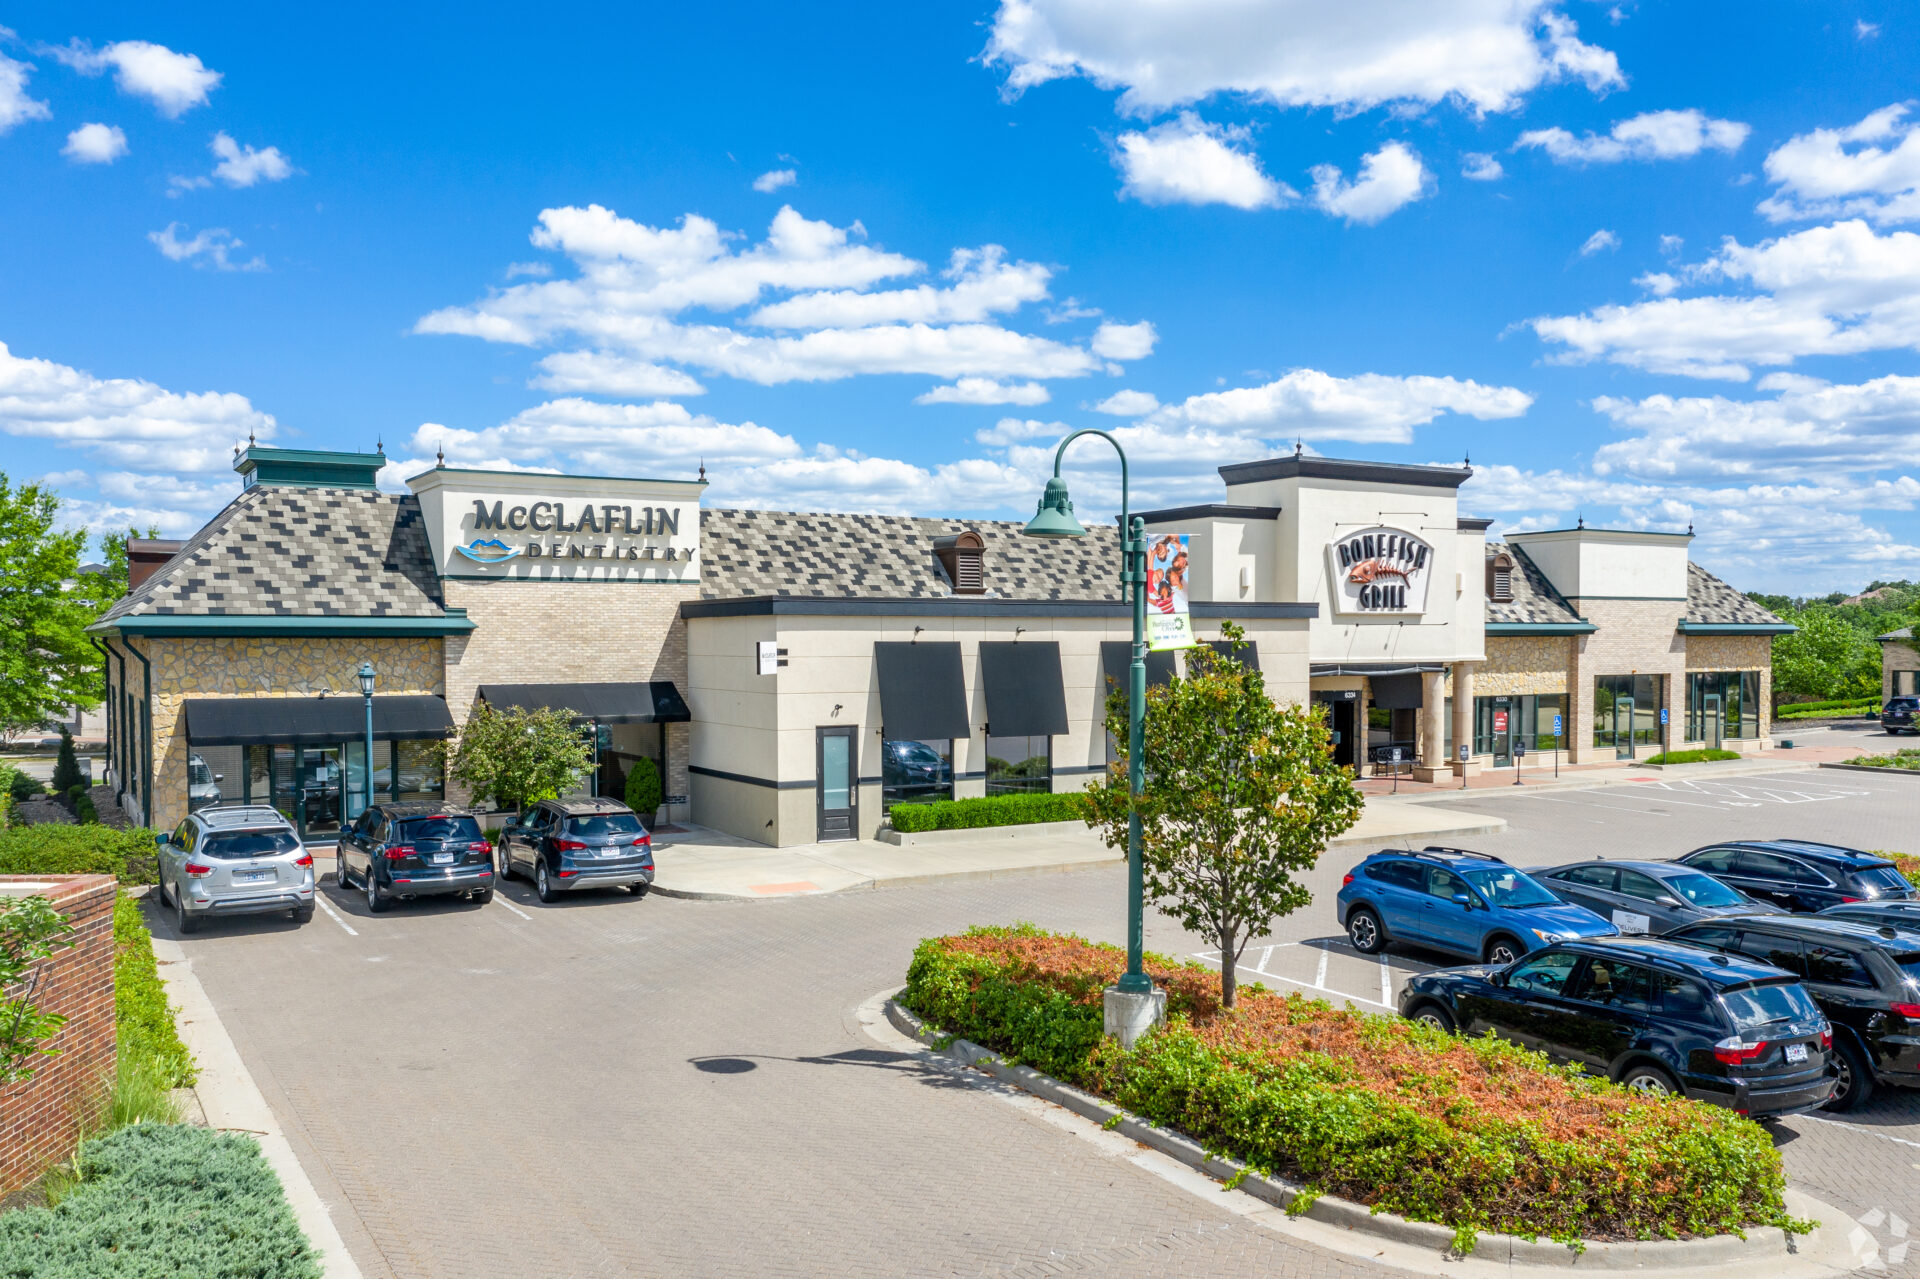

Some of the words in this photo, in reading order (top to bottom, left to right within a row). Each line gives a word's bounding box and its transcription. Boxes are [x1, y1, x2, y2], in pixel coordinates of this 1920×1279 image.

[528, 542, 696, 562] DENTISTRY
[1338, 534, 1428, 569] BONEFISH
[1359, 584, 1408, 608] GRILL
